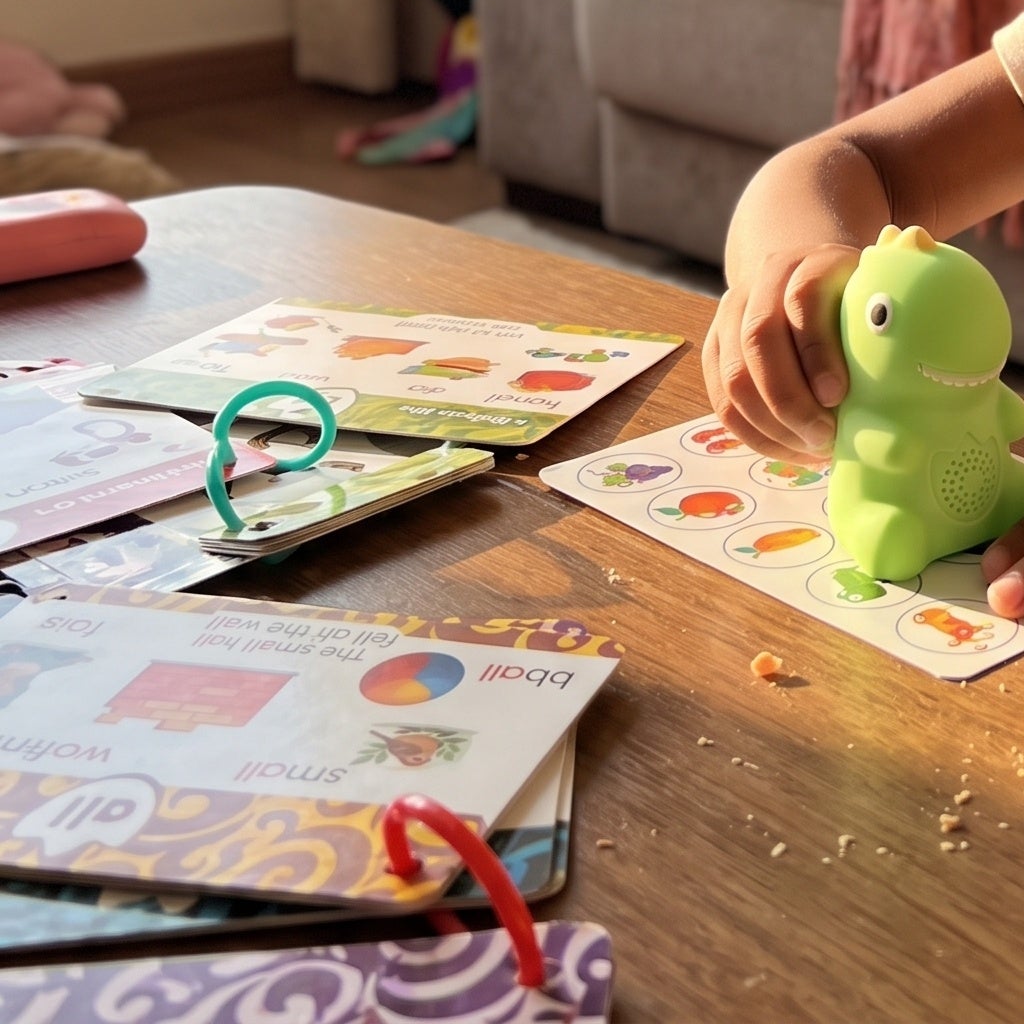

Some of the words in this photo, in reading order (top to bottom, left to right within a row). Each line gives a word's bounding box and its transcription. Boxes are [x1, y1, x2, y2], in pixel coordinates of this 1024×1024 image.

[204, 615, 260, 632] wall
[267, 622, 311, 639] the
[240, 639, 316, 656] small
[351, 630, 399, 648] fell
[319, 646, 365, 662] The
[478, 664, 575, 690] bball
[234, 761, 348, 784] small
[47, 796, 137, 830] all
